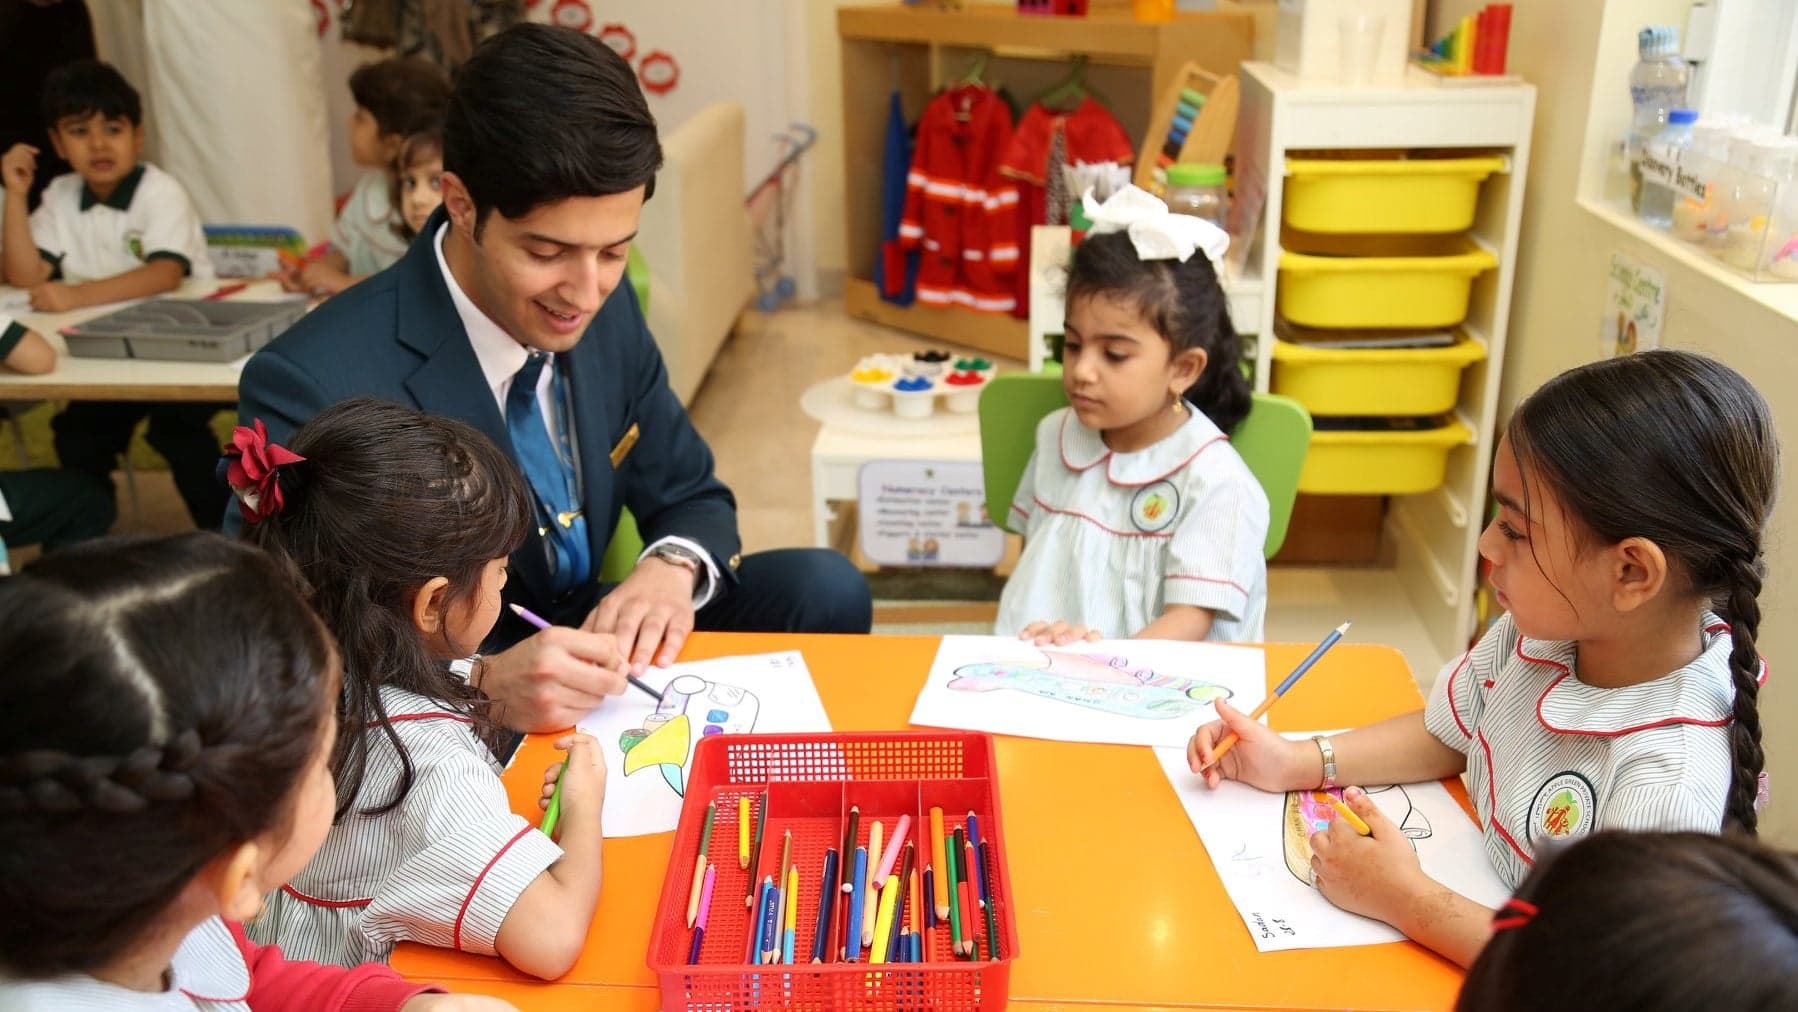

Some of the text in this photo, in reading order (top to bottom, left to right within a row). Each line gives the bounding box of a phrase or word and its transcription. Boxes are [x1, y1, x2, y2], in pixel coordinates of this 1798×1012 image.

[1677, 165, 1706, 198] Bottles
[1548, 779, 1564, 792] APPLE
[1565, 778, 1581, 788] GREEN
[1580, 785, 1592, 808] PRIVATE
